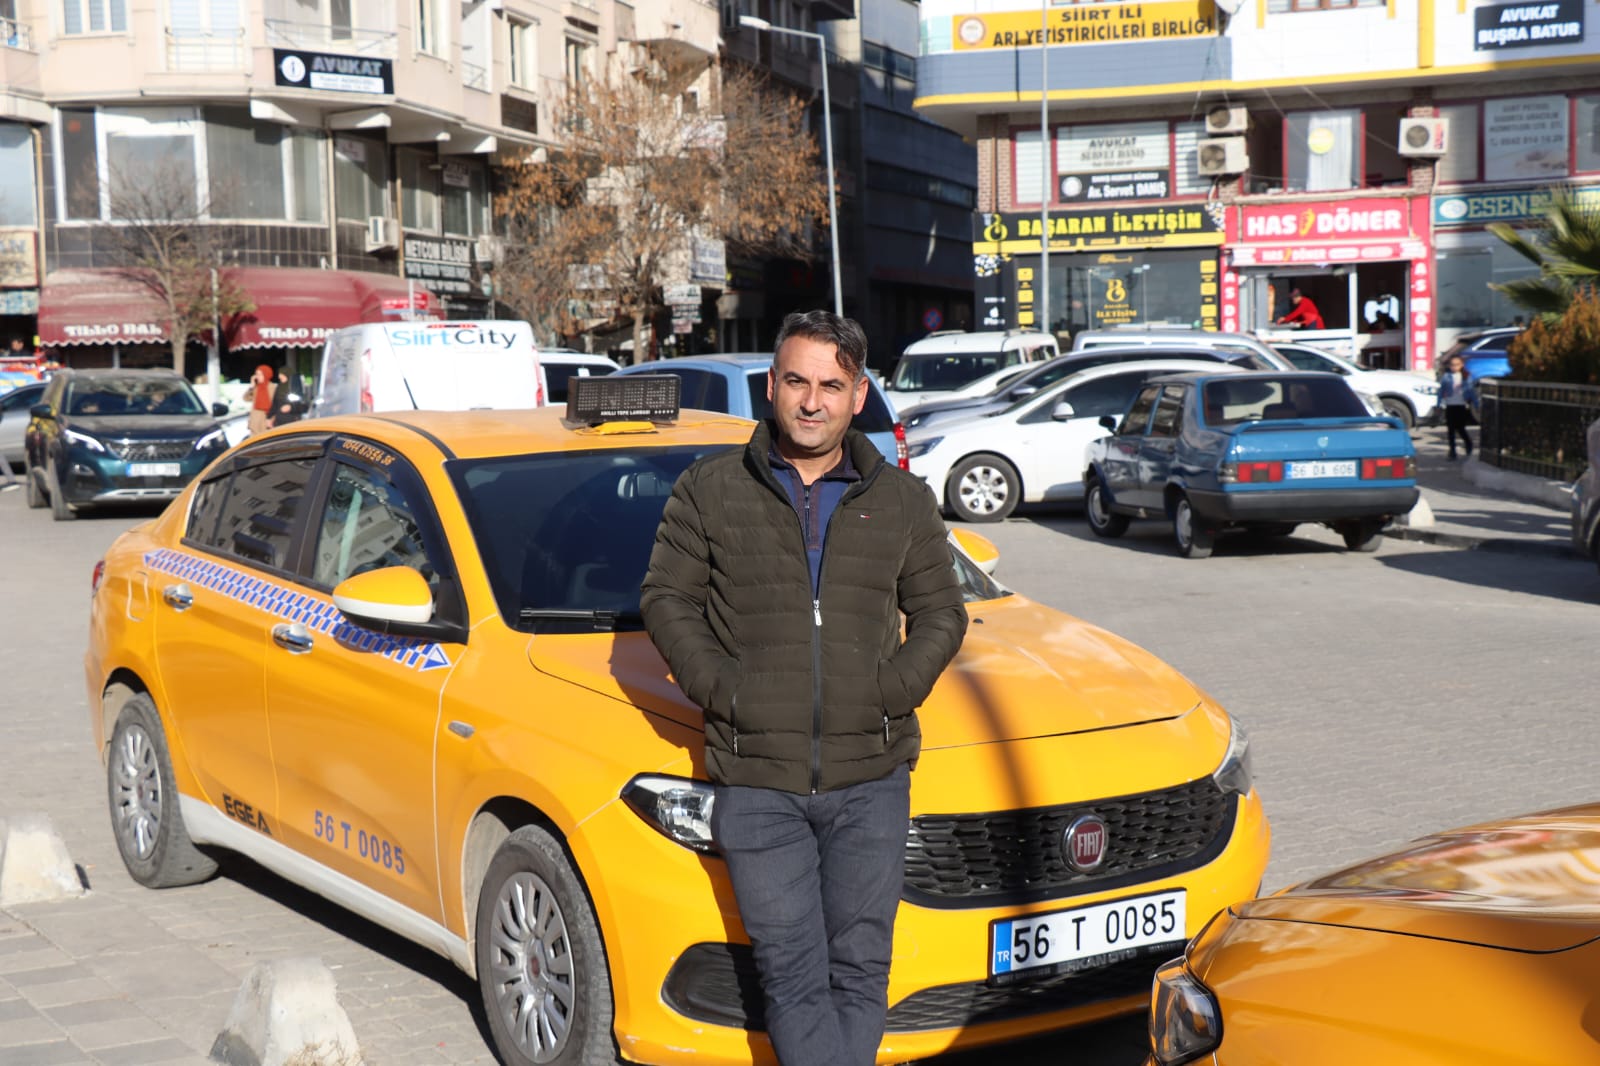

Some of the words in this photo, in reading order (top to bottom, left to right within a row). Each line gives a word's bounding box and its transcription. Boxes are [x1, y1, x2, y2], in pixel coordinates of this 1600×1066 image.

[1062, 8, 1110, 22] SİİRT
[1119, 4, 1142, 19] İLİ
[1500, 5, 1560, 23] AVUKAT
[1530, 22, 1581, 39] BATUR
[312, 56, 383, 76] AVUKAT
[1089, 137, 1137, 148] AVUKAT
[1103, 184, 1134, 197] Servet
[1136, 181, 1166, 198] DANIŞ
[1468, 195, 1528, 218] ESEN
[1018, 216, 1106, 238] BAŞARAN
[1113, 208, 1202, 233] İLETİŞİM
[1247, 214, 1297, 237] HAS
[1317, 207, 1402, 233] DÖNER
[1293, 464, 1306, 477] 56
[222, 792, 272, 836] EGEA
[314, 808, 335, 843] 56
[341, 820, 352, 849] T
[358, 828, 405, 875] 0085
[1077, 830, 1101, 857] FIAT
[997, 951, 1010, 963] TR
[1014, 923, 1050, 963] 56
[1072, 916, 1086, 951] T
[1105, 898, 1177, 944] 0085
